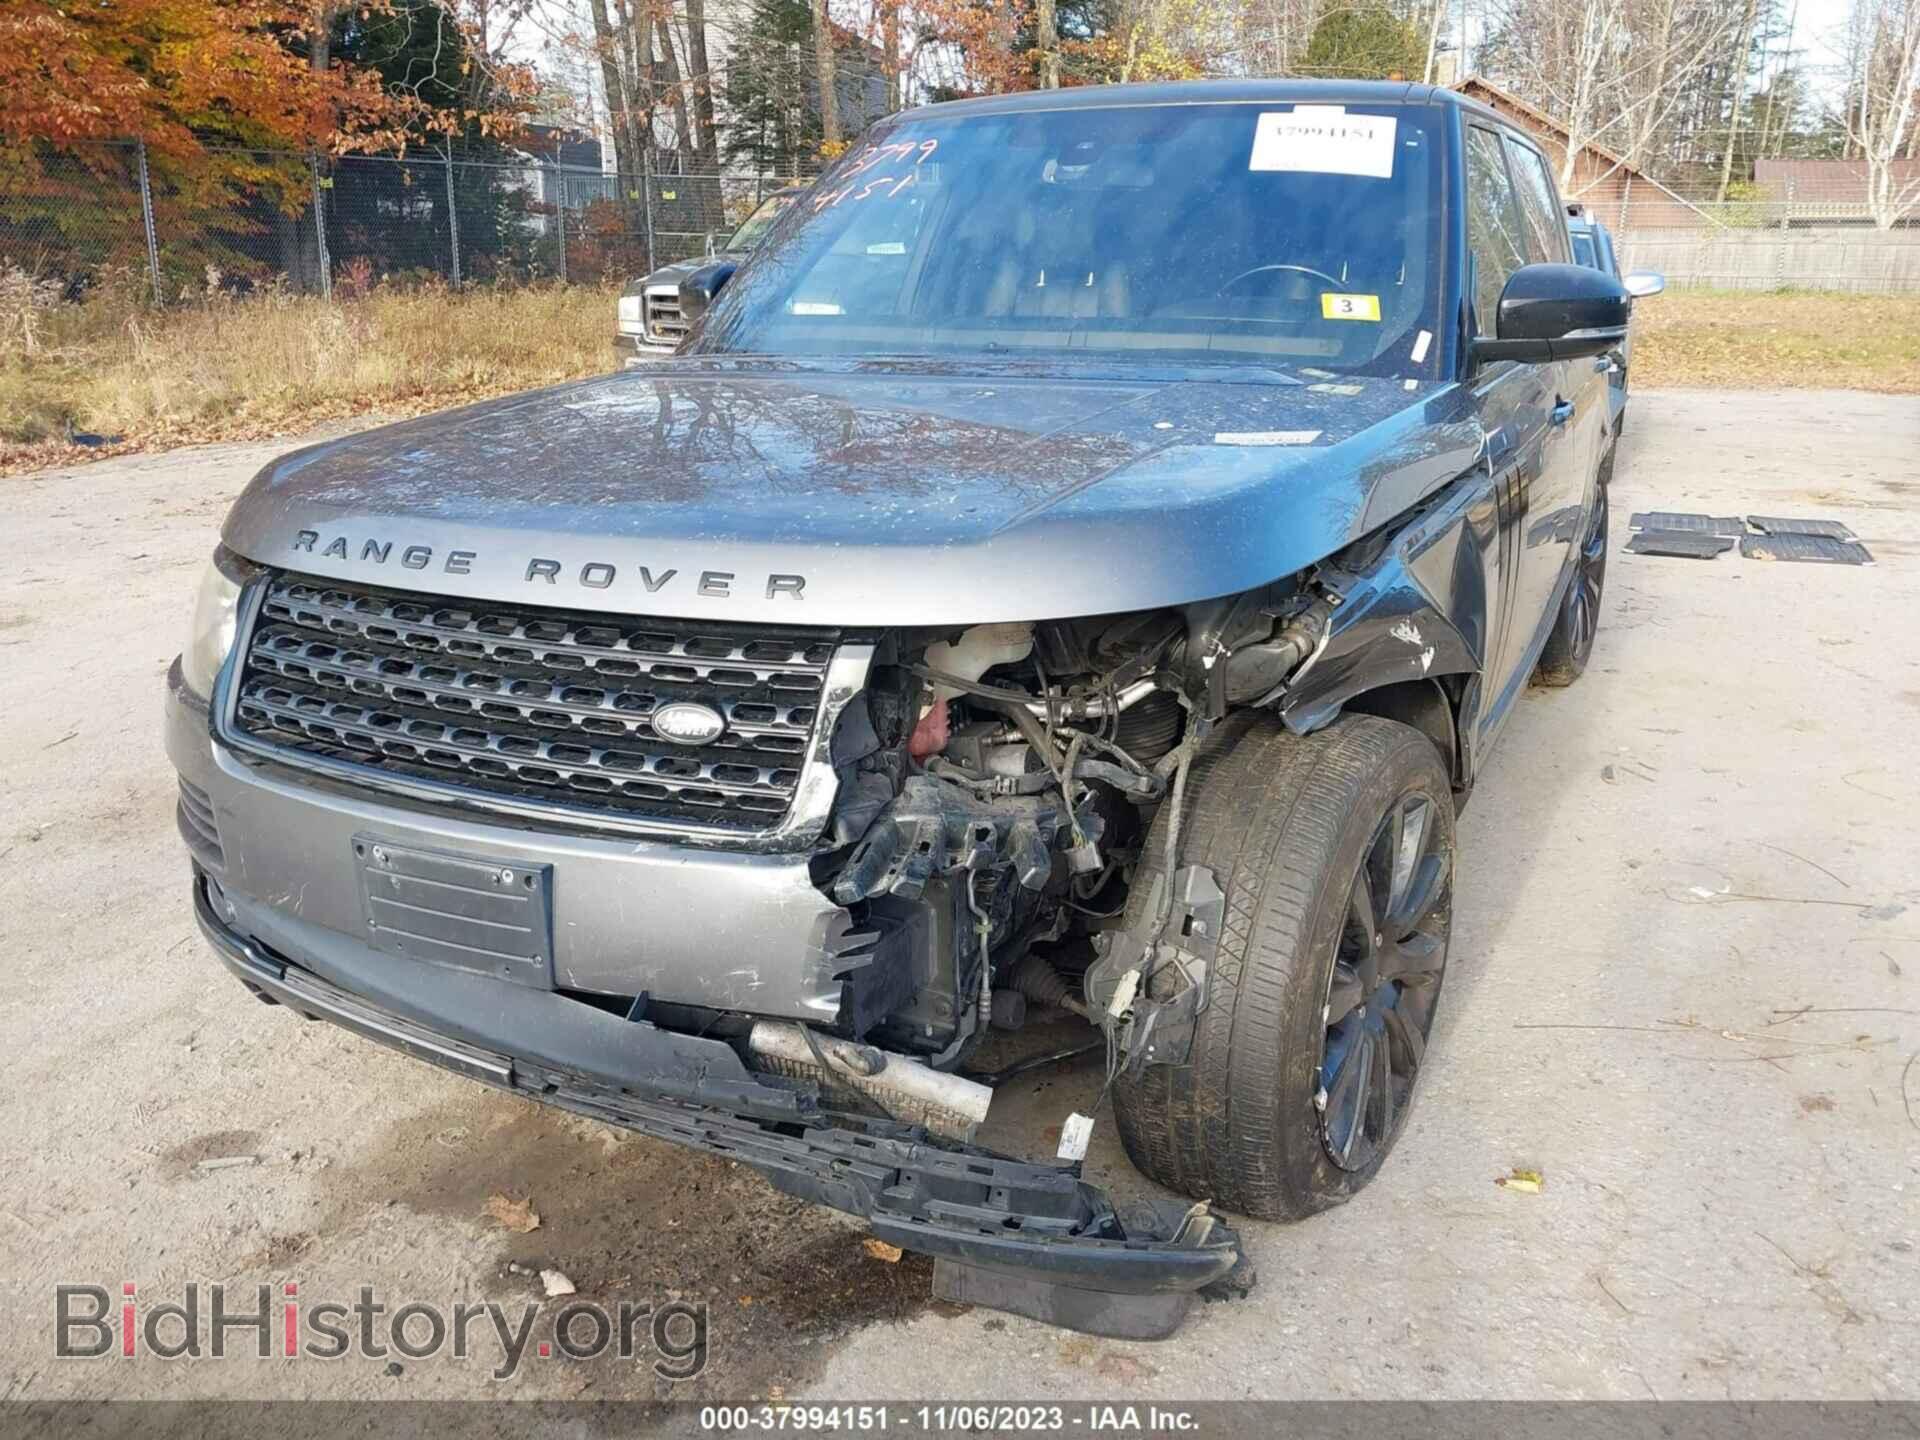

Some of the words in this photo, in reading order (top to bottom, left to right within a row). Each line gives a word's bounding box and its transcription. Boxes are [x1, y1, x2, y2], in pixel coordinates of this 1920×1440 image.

[1340, 298, 1353, 313] 3
[294, 530, 477, 575] RANGE
[525, 557, 807, 600] ROVER
